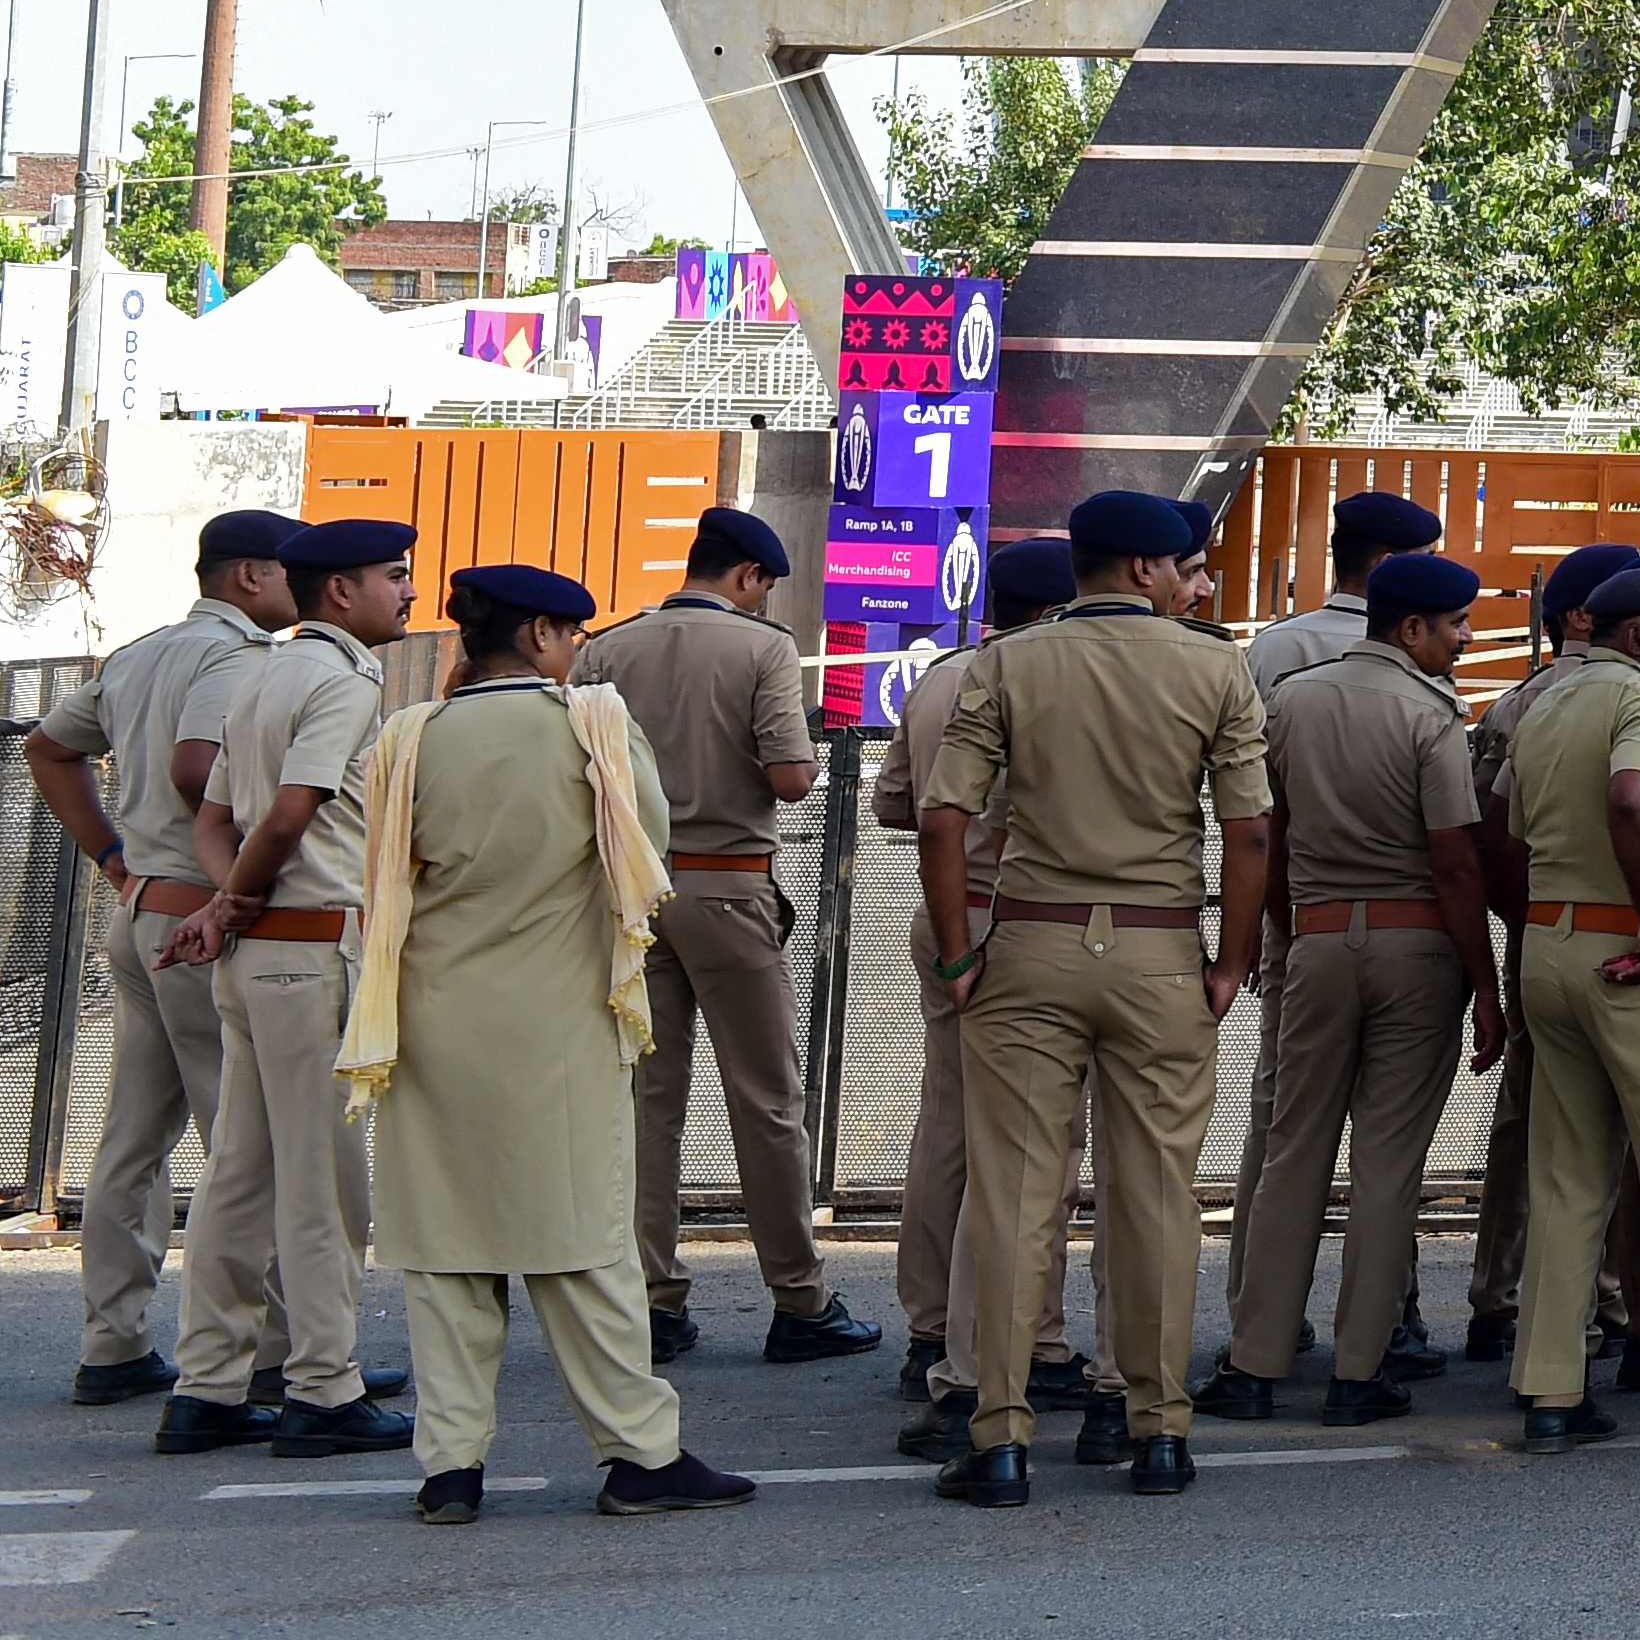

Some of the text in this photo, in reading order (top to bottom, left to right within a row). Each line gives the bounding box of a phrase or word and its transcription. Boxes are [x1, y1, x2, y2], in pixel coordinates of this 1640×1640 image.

[122, 330, 138, 420] BCC
[903, 404, 970, 425] GATE
[914, 432, 951, 497] 1
[845, 519, 913, 532] Ramp 1A, 1B
[892, 551, 912, 562] ICC
[828, 564, 911, 579] Merchandising
[861, 596, 909, 609] Fanzone
